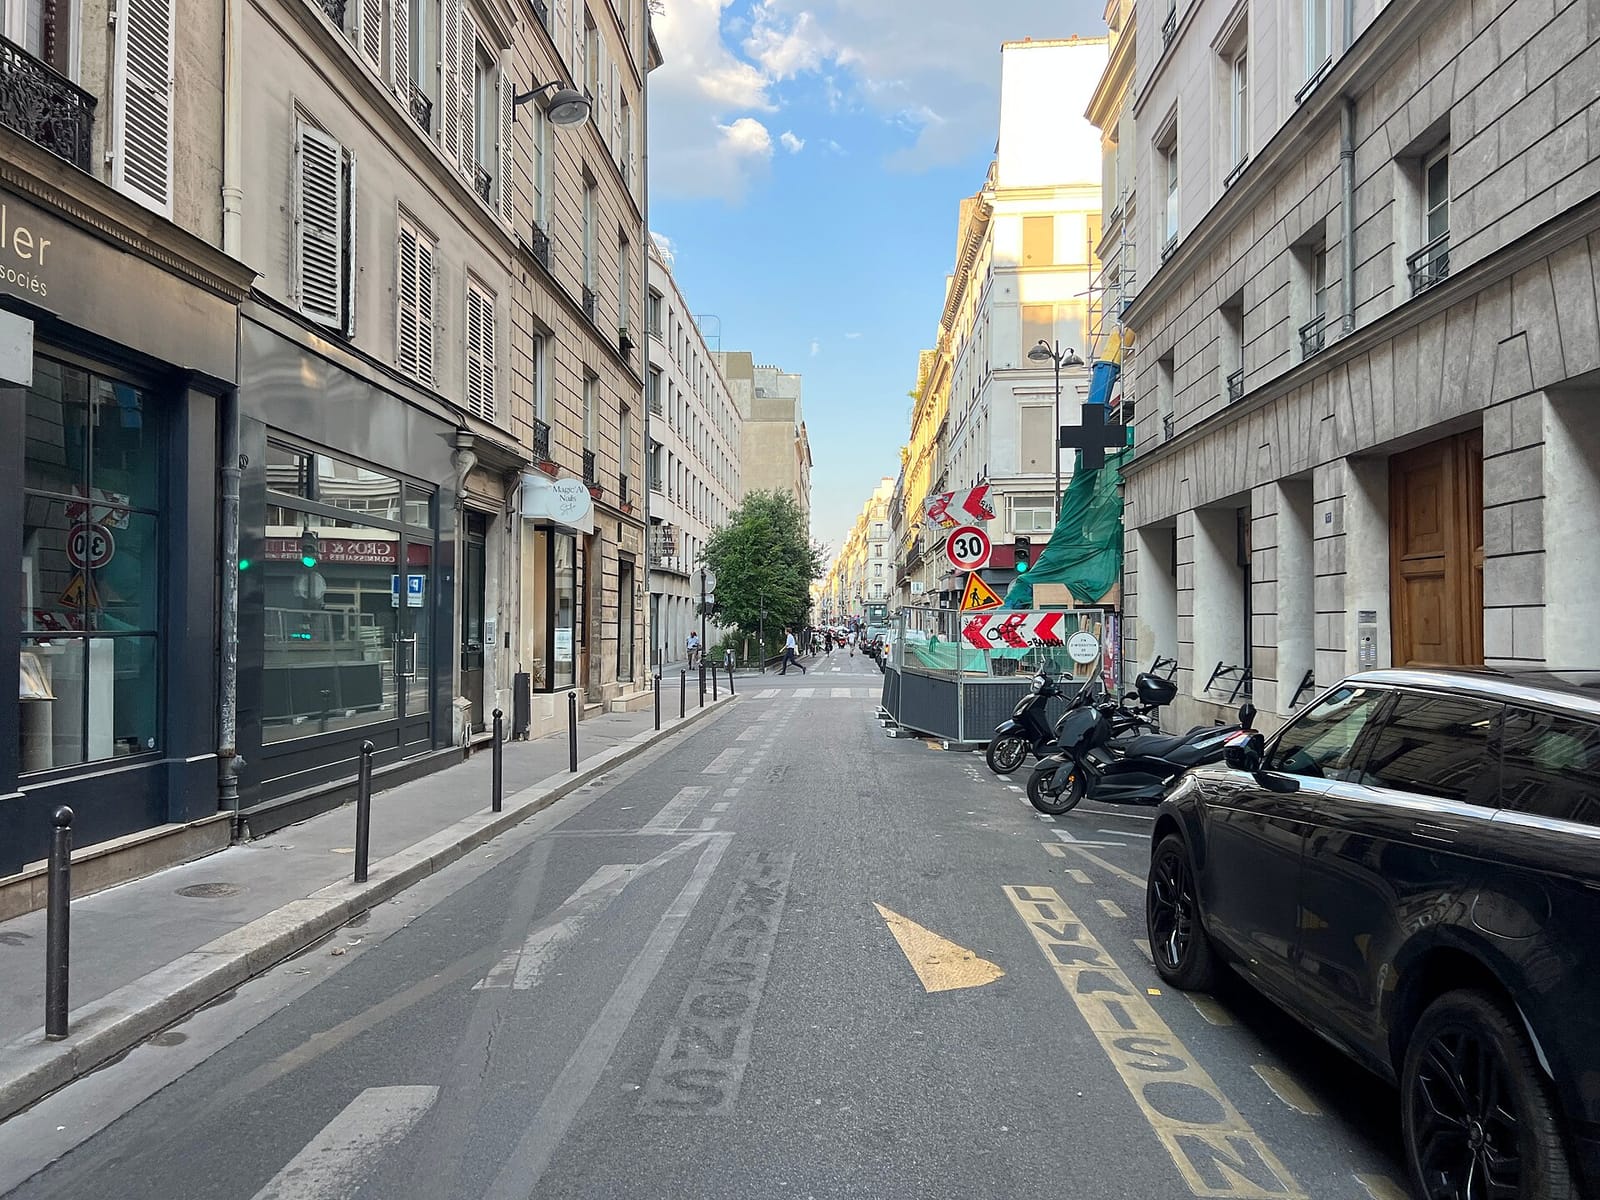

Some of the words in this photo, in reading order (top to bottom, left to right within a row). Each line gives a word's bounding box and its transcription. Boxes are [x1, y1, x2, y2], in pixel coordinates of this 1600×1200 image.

[1, 204, 51, 266] ler
[0, 264, 48, 297] sociés
[955, 536, 982, 559] 30
[1010, 886, 1288, 1192] LIVRAISON
